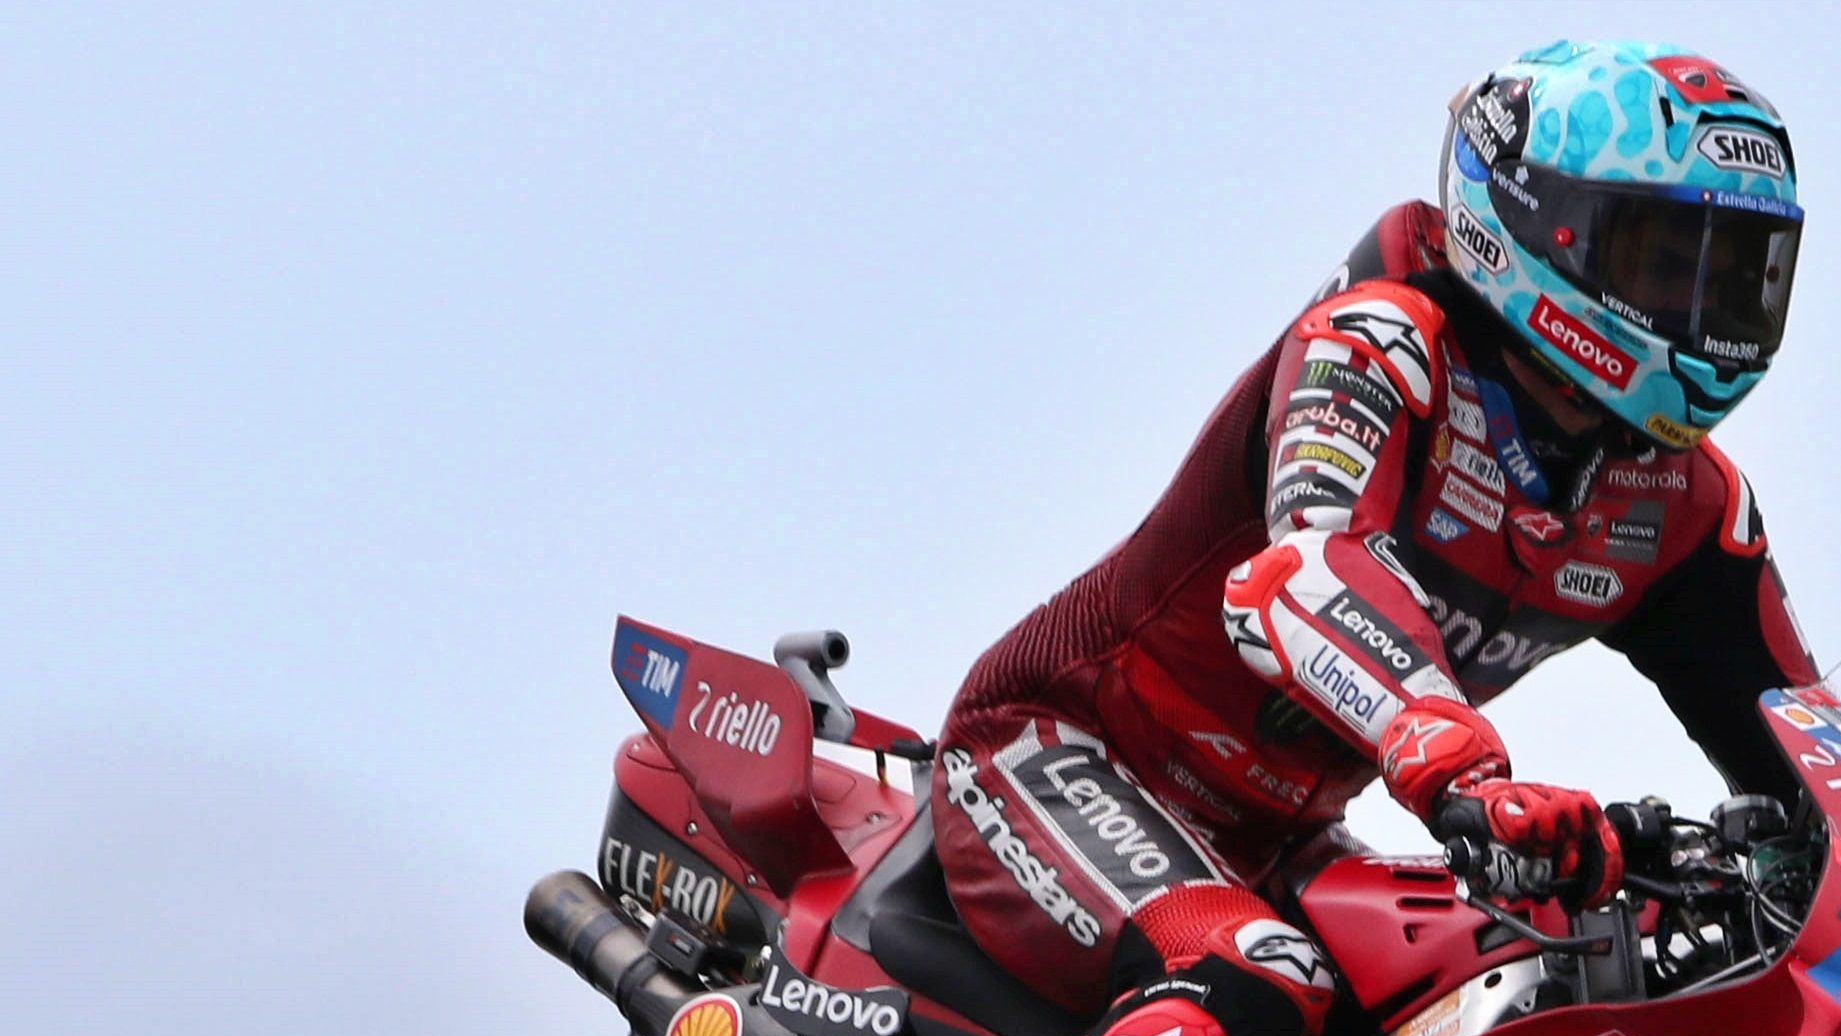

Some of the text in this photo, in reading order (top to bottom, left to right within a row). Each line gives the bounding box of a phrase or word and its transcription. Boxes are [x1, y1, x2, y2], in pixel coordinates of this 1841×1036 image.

[1713, 134, 1782, 174] SHOEI
[1453, 212, 1501, 270] SHOEI
[1601, 291, 1654, 331] VERTICAL
[1538, 305, 1624, 378] Lenovo
[1703, 334, 1760, 361] Insta360
[1286, 402, 1382, 452] aruba.it
[1501, 437, 1538, 488] TIM
[1607, 469, 1688, 491] motorola
[1610, 520, 1656, 539] Lenovo
[1561, 566, 1614, 600] SHOEI
[1329, 596, 1413, 671] Lenovo
[640, 648, 681, 698] TIM
[1309, 643, 1388, 724] Unipol
[704, 691, 782, 757] riello
[1042, 754, 1170, 879] Lenovo
[603, 836, 737, 935] FLEX-ROX
